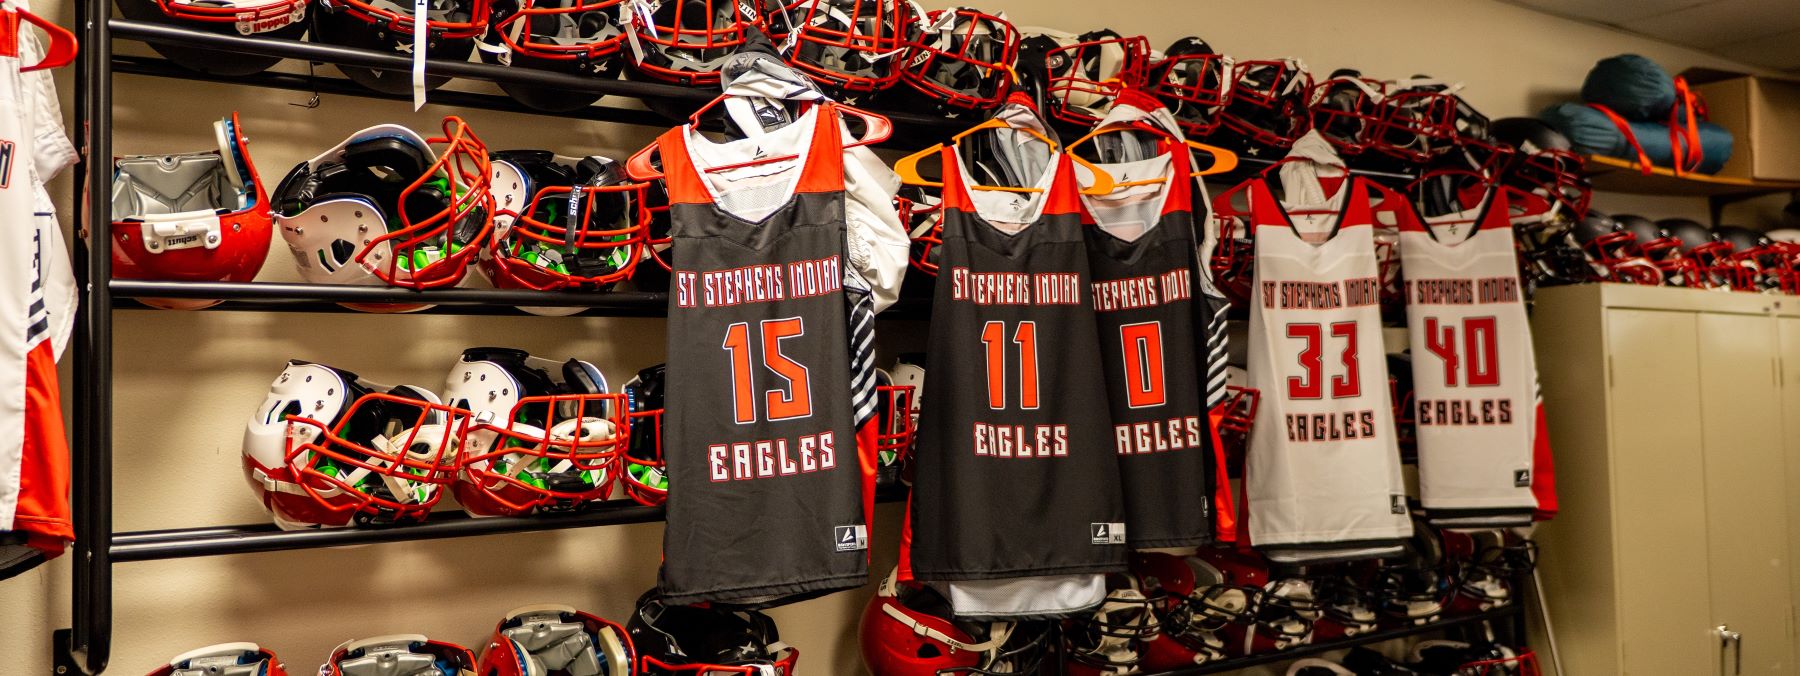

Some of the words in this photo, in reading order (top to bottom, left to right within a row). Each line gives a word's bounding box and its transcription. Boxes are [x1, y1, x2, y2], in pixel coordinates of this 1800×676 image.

[253, 14, 290, 33] Riddell
[168, 235, 198, 246] schutt
[676, 270, 698, 308] ST
[702, 264, 785, 307] STEPHENS
[788, 255, 841, 299] INDIAN
[952, 266, 970, 300] ST
[970, 272, 1030, 305] TEPHENS
[1034, 273, 1080, 305] INDIAN
[1160, 267, 1192, 304] INDIA
[1262, 280, 1276, 309] ST
[1280, 280, 1342, 310] STEPHENS
[1404, 279, 1412, 305] T
[1416, 278, 1473, 305] STEPHENS
[1478, 277, 1518, 304] INDIAN
[722, 315, 813, 425] 15
[981, 320, 1040, 410] 11
[1120, 320, 1166, 409] 0
[1286, 320, 1361, 400] 33
[1423, 315, 1500, 388] 40
[1417, 398, 1512, 426] EAGLES
[974, 421, 1068, 458] EAGLES
[1112, 415, 1200, 455] AGLES
[708, 431, 837, 483] EAGLES
[1113, 534, 1122, 542] XL
